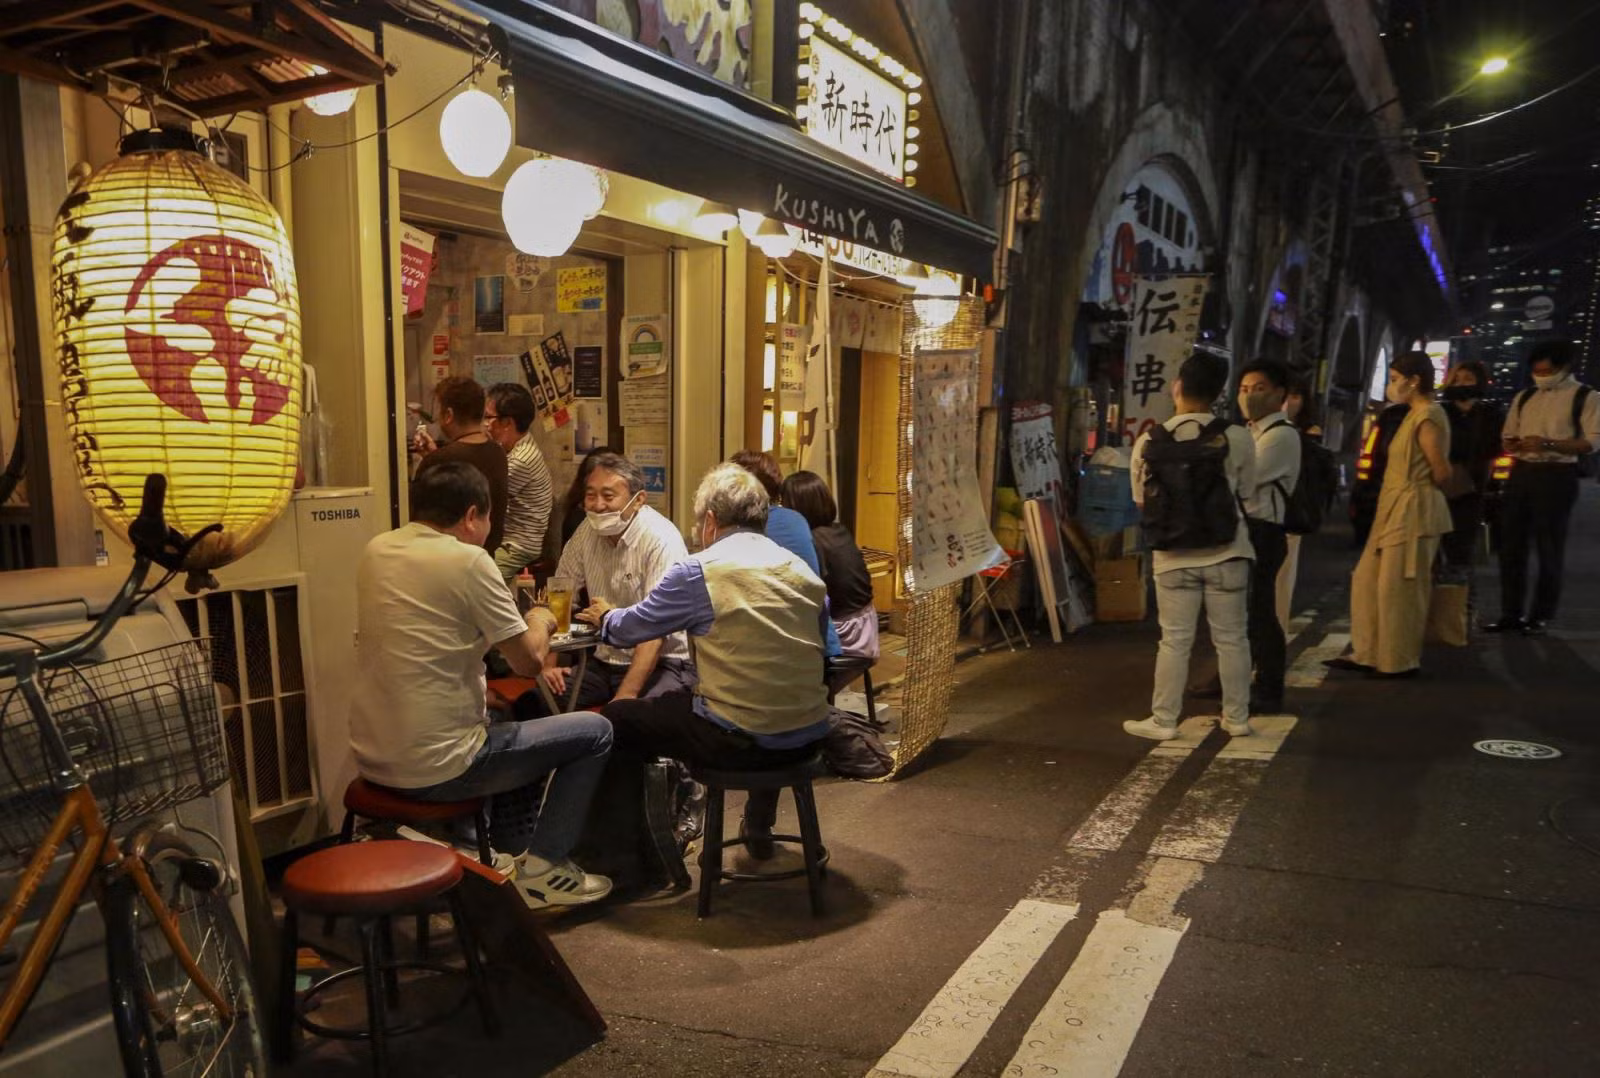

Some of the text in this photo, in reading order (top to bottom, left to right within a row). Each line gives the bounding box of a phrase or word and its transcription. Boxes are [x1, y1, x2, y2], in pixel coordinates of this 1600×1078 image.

[821, 70, 897, 166] 新時代
[775, 184, 879, 244] KUSHIYA
[1131, 289, 1181, 409] 伝串
[311, 508, 361, 522] TOSHIBA
